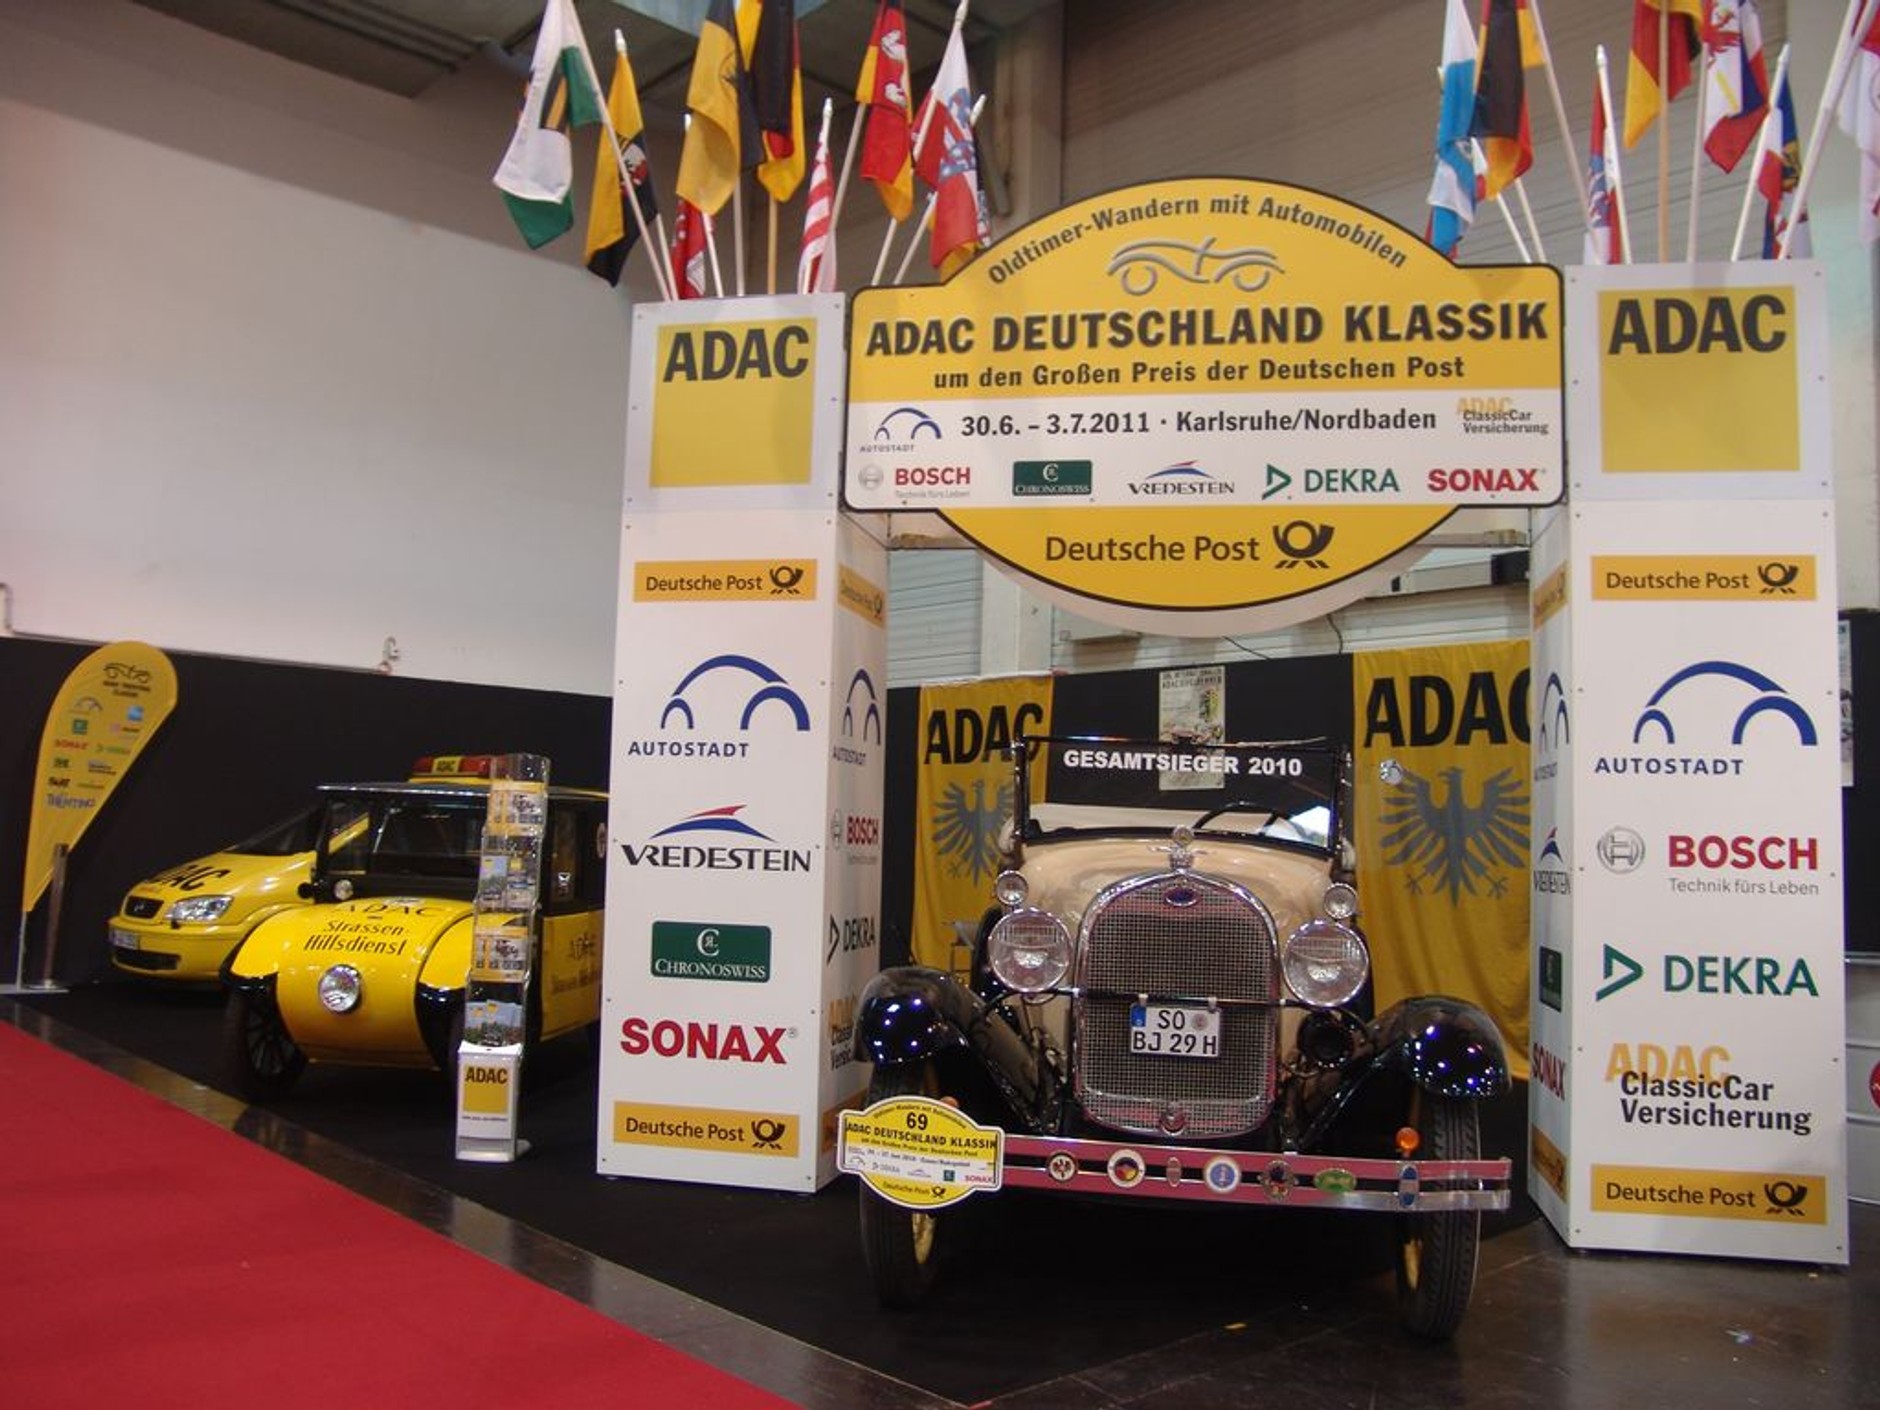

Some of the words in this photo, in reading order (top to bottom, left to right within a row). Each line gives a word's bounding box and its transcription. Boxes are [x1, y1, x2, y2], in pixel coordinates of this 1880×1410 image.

[988, 197, 1199, 285] Oldtimer-Wandern
[1210, 194, 1250, 214] mit
[1258, 196, 1407, 268] Automobilen
[866, 317, 974, 356] ADAC
[993, 306, 1323, 352] DEUTSCHLAND
[1345, 301, 1548, 342] KLASSIK
[1608, 294, 1787, 355] ADAC
[663, 325, 809, 383] ADAC
[934, 371, 968, 388] um
[979, 367, 1022, 387] den
[1033, 363, 1120, 386] Großen
[1132, 361, 1196, 383] Preis
[1207, 359, 1249, 381] der
[1259, 357, 1396, 381] Deutschen
[1408, 356, 1465, 378] Post
[961, 414, 1021, 437] 30.6.
[1046, 413, 1150, 435] 3.7.2011
[1176, 408, 1437, 432] Karlsruhe/Nordbaden
[1463, 410, 1531, 421] ClassicCar
[1463, 422, 1549, 435] Versicherung
[895, 467, 971, 486] BOSCH
[1127, 483, 1235, 496] VREDESTEIN
[1304, 468, 1400, 493] DEKRA
[1427, 468, 1540, 492] SONAX
[1045, 534, 1186, 562] Deutsche
[1194, 535, 1260, 562] Post
[646, 574, 722, 592] Deutsche
[726, 575, 763, 590] Post
[1605, 571, 1700, 589] Deutsche
[1706, 571, 1750, 589] Post
[924, 702, 1043, 765] ADAC
[628, 740, 749, 757] AUTOSTADT
[1063, 749, 1239, 774] GESAMTSIEGER
[1248, 756, 1303, 777] 2010
[1594, 757, 1744, 775] AUTOSTADT
[847, 816, 880, 845] BOSCH
[620, 844, 811, 873] VREDESTEIN
[1668, 835, 1818, 870] BOSCH
[1669, 877, 1731, 893] Technik
[1735, 877, 1765, 894] fürs
[1769, 878, 1819, 896] Leben
[843, 915, 876, 951] DEKRA
[655, 957, 767, 979] CHRONOSWISS
[1664, 954, 1819, 997] DEKRA
[1158, 1009, 1186, 1031] SO
[620, 1017, 787, 1064] SONAX
[1132, 1031, 1162, 1052] BJ
[1169, 1033, 1197, 1054] 29
[1203, 1035, 1217, 1055] H
[465, 1066, 508, 1085] ADAC
[1605, 1042, 1731, 1083] ADAC
[1620, 1070, 1775, 1101] ClassicCar
[626, 1117, 703, 1139] Deutsche
[708, 1120, 745, 1142] Post
[906, 1112, 928, 1131] 69
[1620, 1098, 1812, 1136] Versicherung
[874, 1127, 947, 1146] DEUTSCHLAND
[1605, 1181, 1704, 1204] Deutsche
[1709, 1186, 1756, 1208] Post
